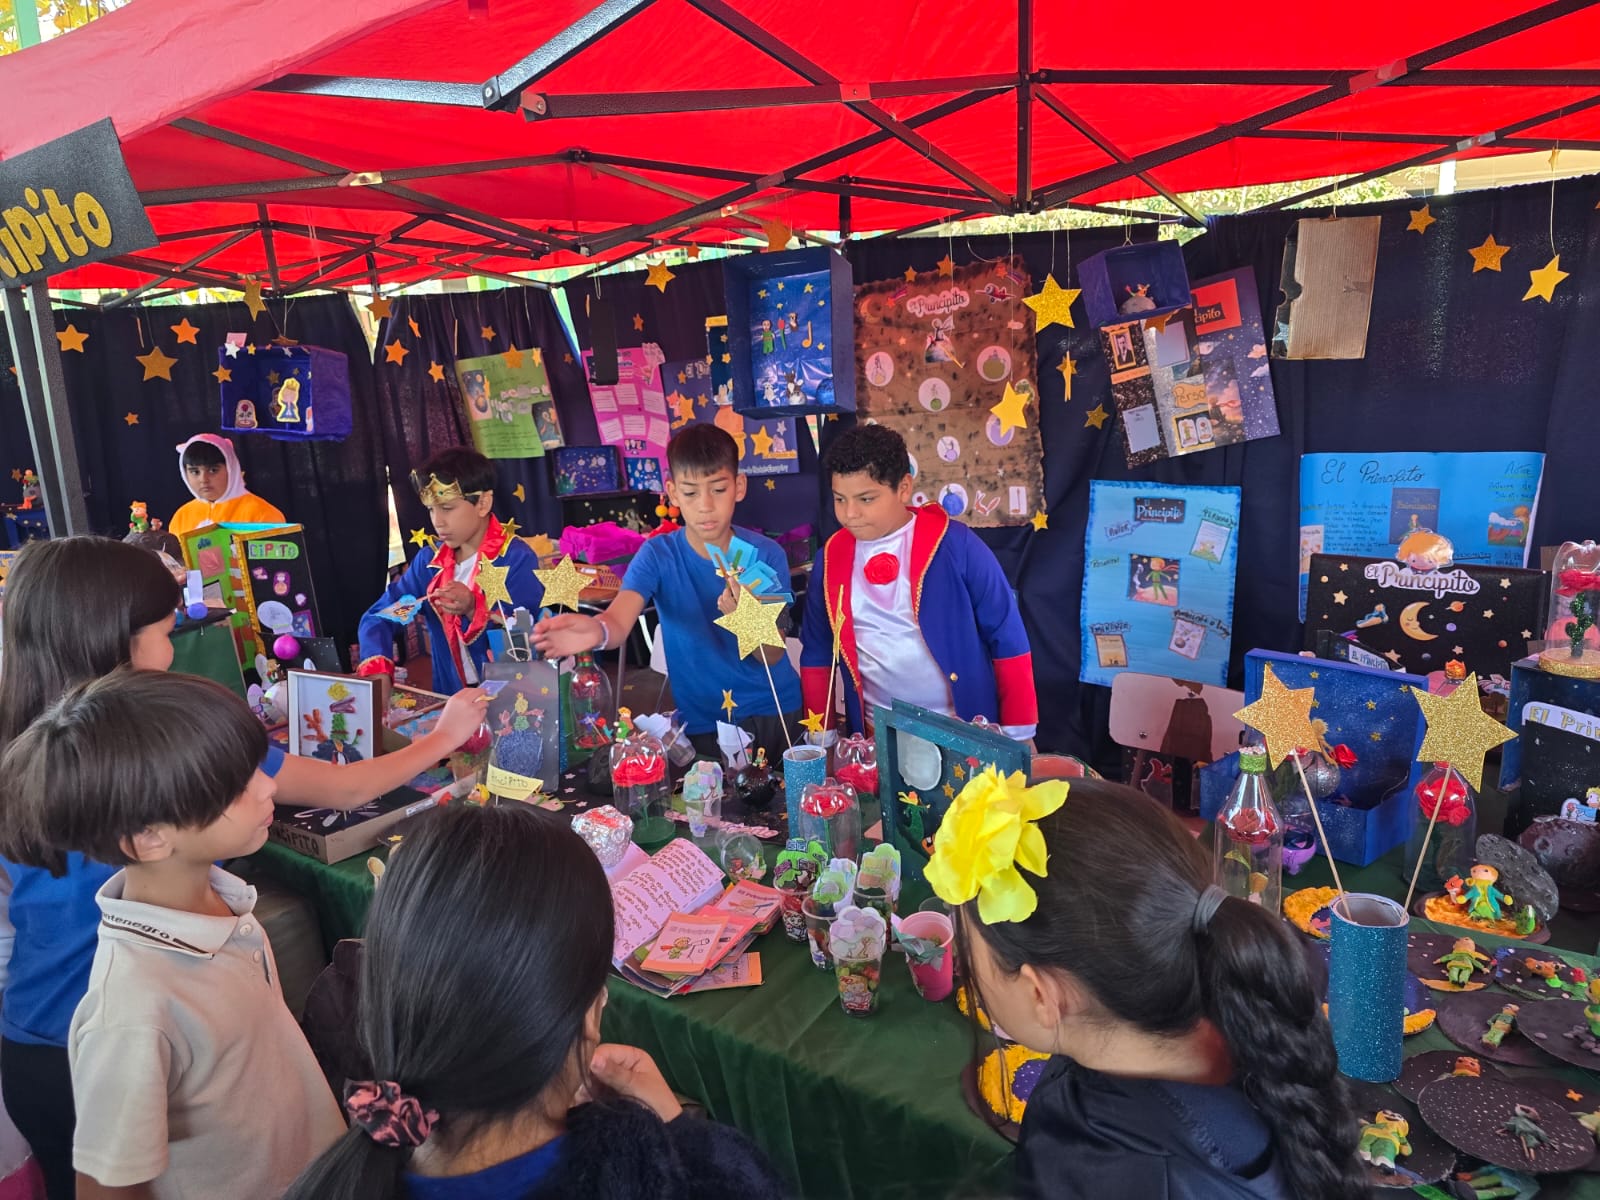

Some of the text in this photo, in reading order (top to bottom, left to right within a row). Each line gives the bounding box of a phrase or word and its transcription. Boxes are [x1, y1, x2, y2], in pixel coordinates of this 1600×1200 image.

[1320, 459, 1345, 484] El
[1136, 504, 1184, 522] Principito
[1366, 564, 1479, 598] El Principito
